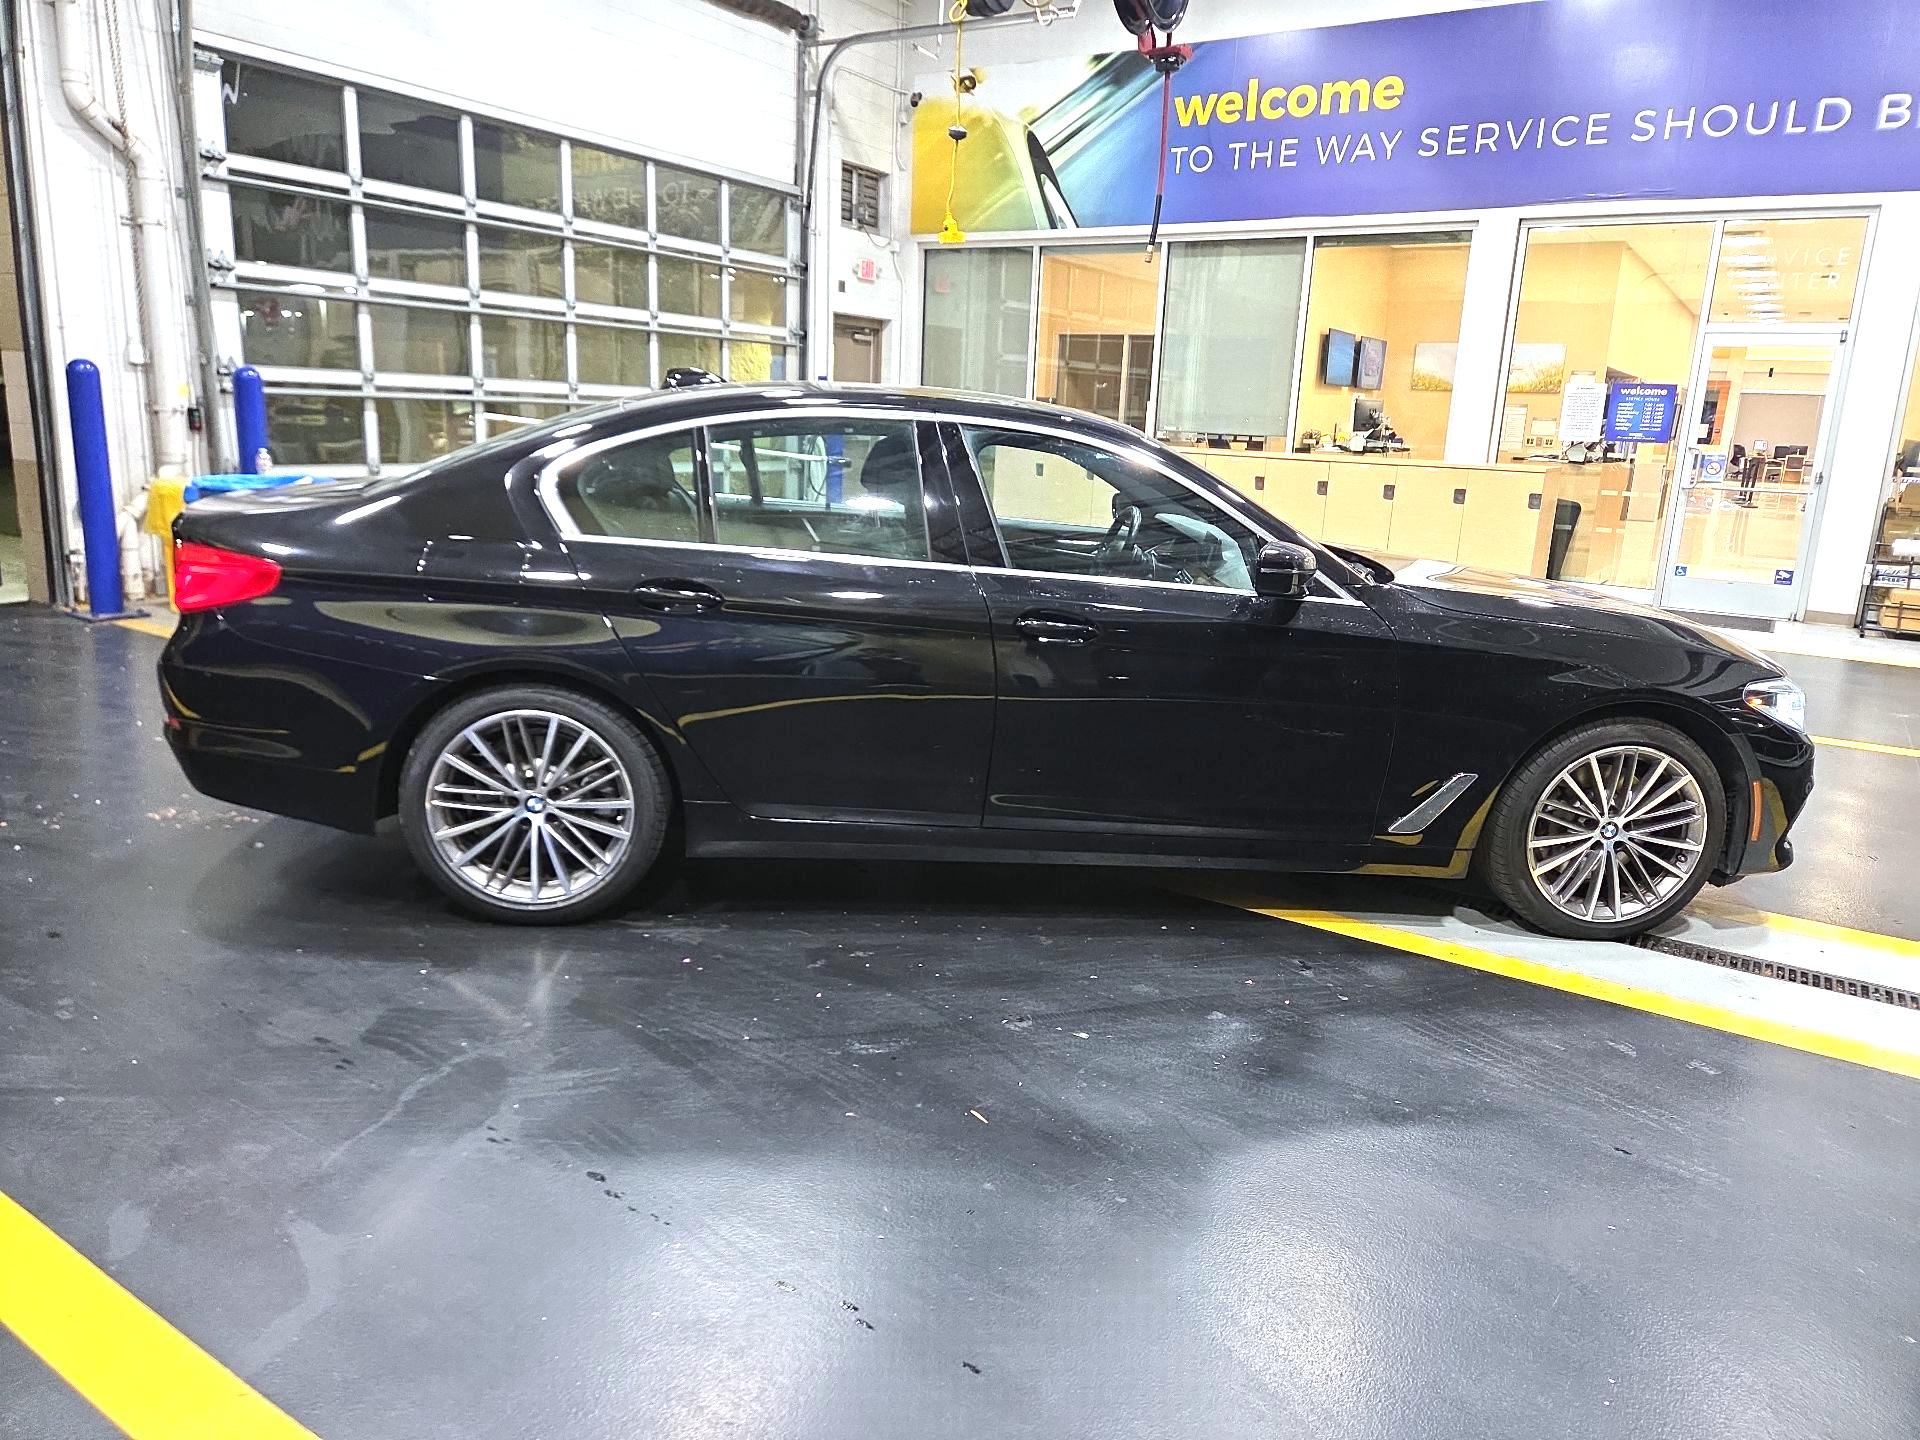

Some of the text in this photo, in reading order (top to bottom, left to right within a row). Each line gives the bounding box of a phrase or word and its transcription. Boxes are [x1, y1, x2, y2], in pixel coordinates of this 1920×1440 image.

[1174, 74, 1404, 127] welcome
[1170, 145, 1213, 174] TO
[1228, 138, 1299, 170] THE
[1315, 130, 1403, 165] WAY
[1418, 112, 1611, 157] SERVICE
[1630, 97, 1852, 142] SHOULD
[1620, 385, 1668, 396] welcome
